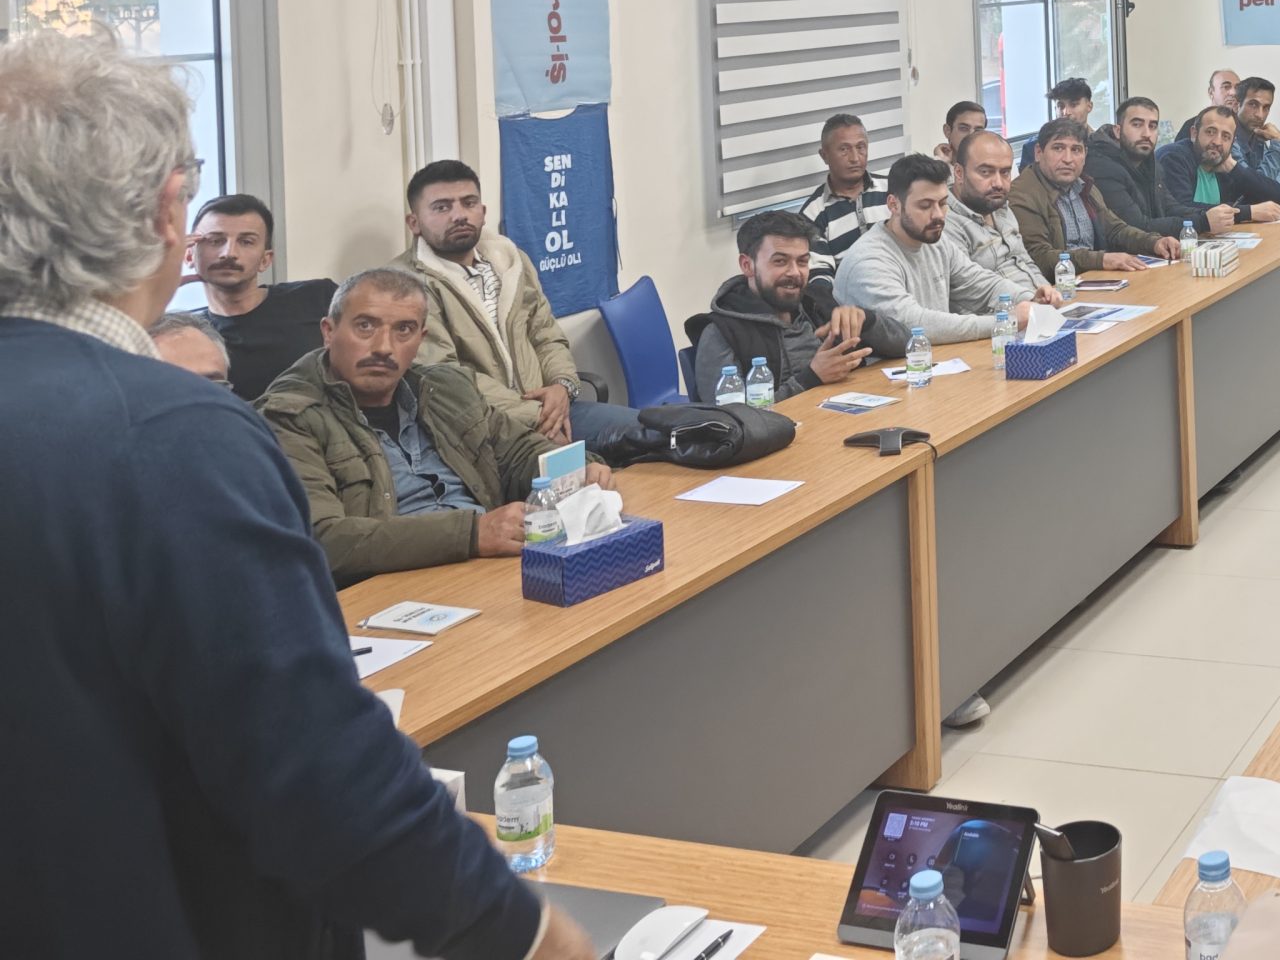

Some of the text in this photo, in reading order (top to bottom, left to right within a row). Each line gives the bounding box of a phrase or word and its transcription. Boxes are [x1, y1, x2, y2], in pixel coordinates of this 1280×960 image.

[544, 154, 571, 172] SEN
[549, 191, 568, 209] KA
[551, 210, 566, 227] LI
[545, 230, 573, 253] OL
